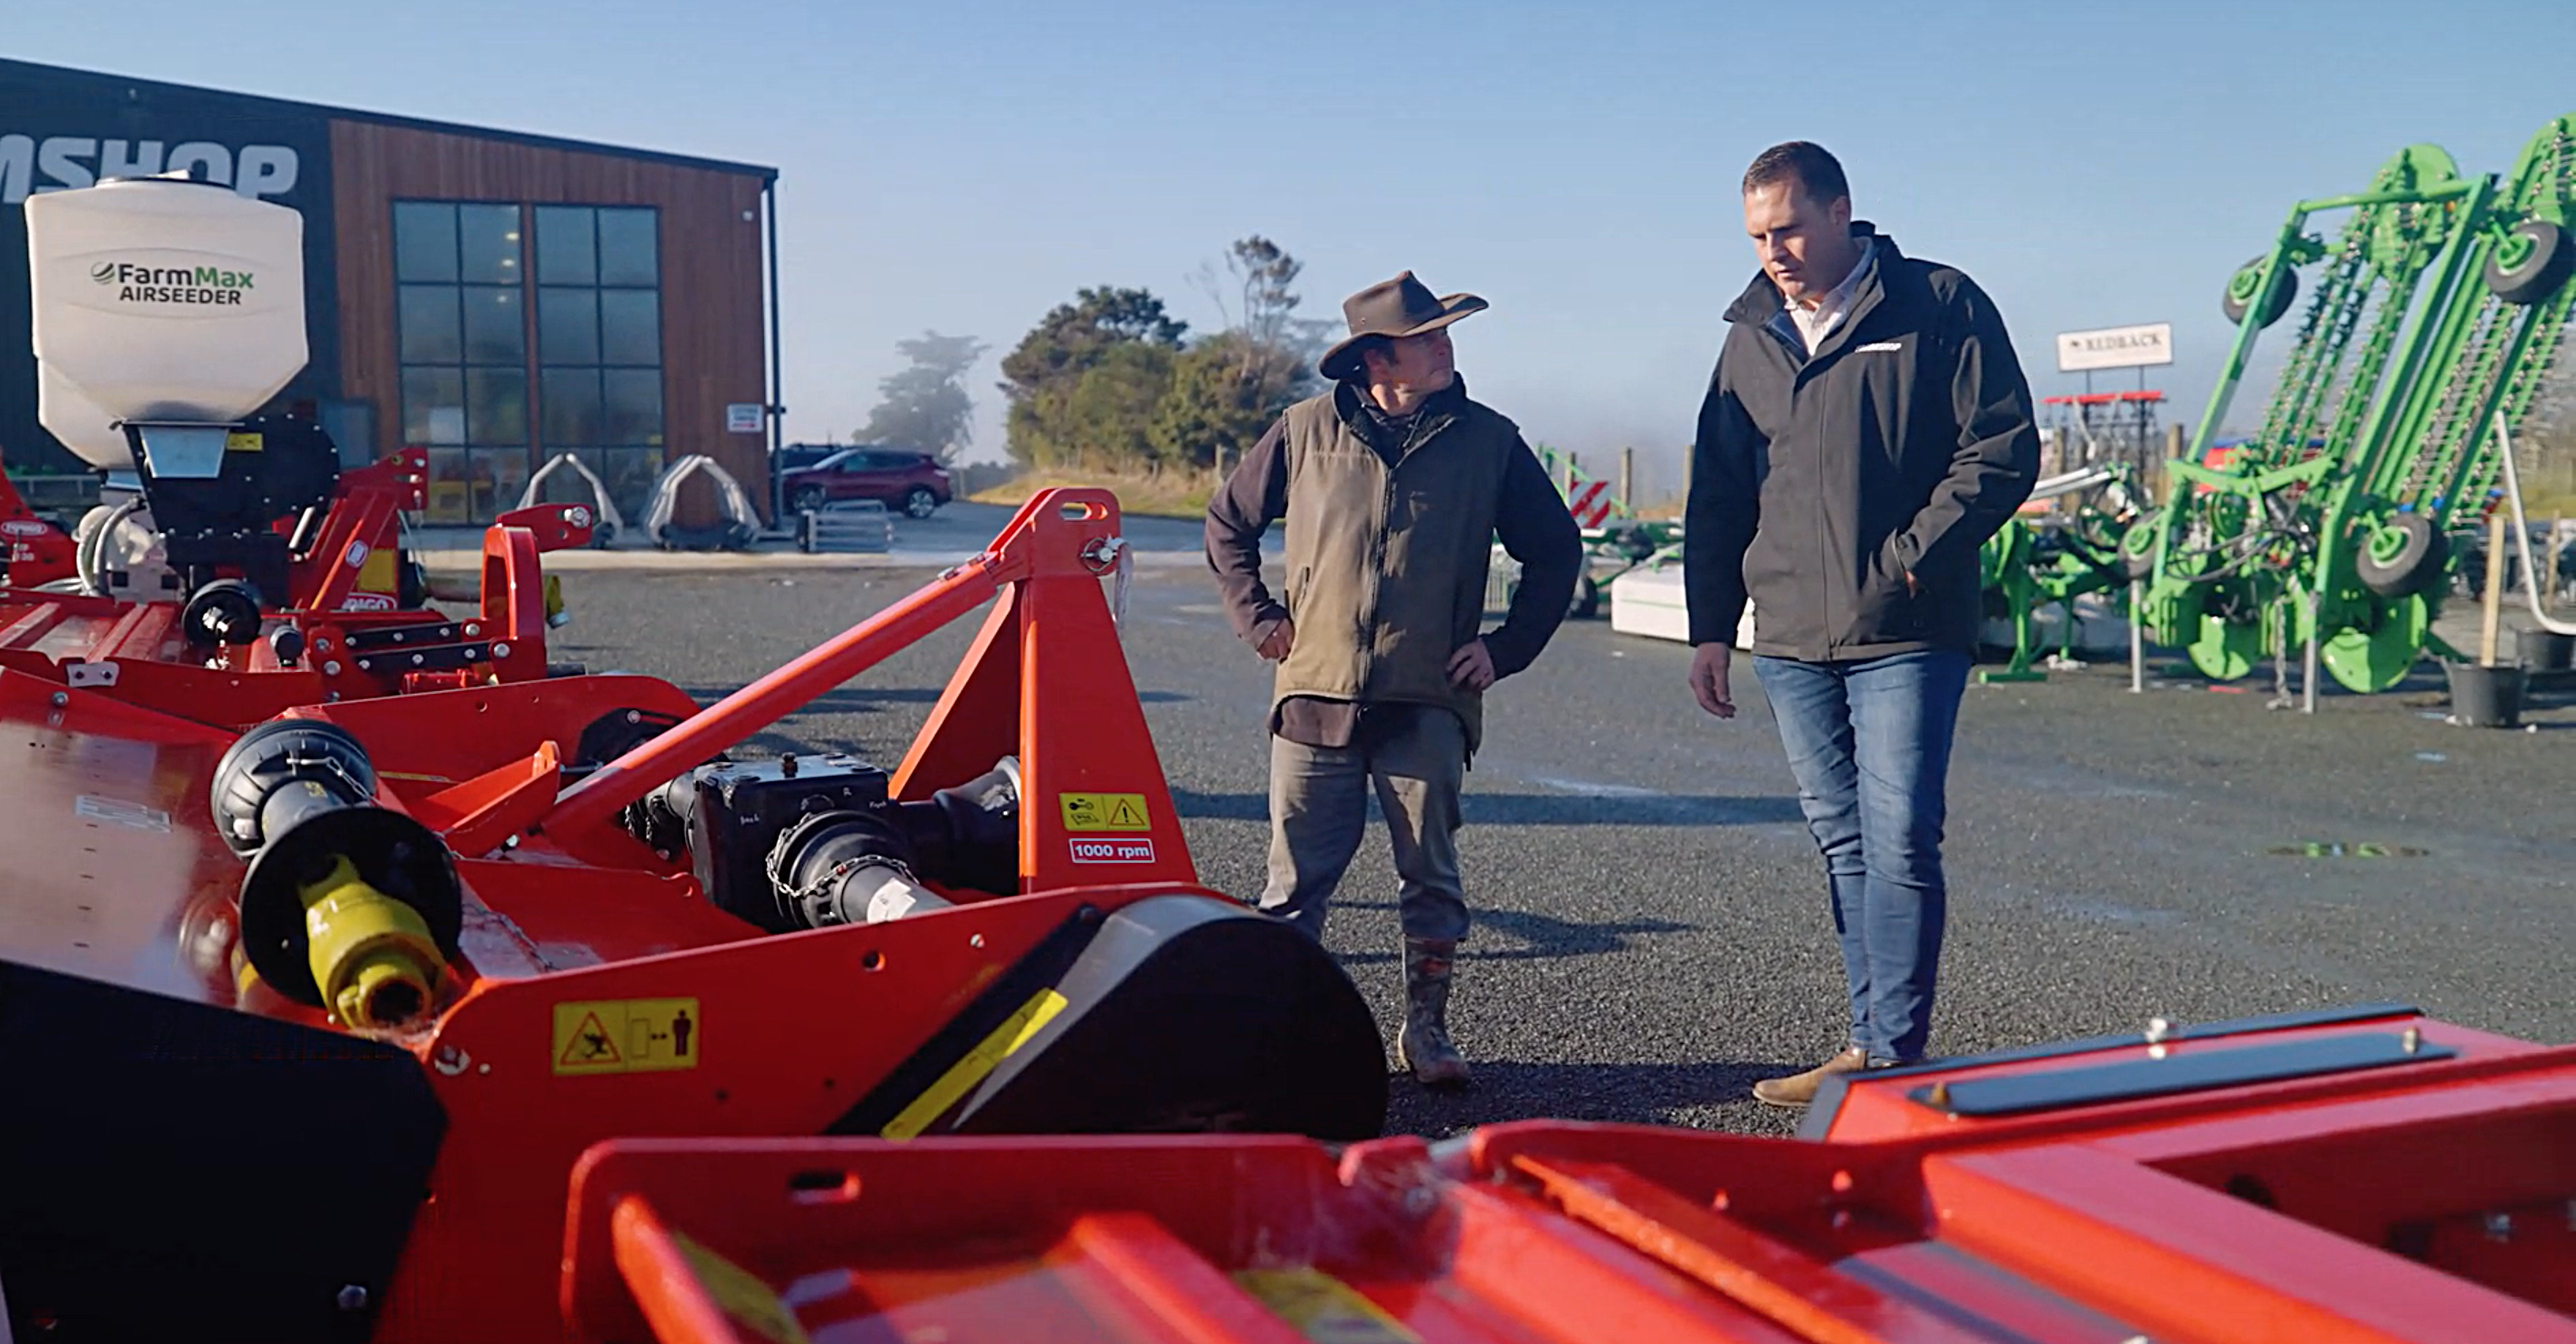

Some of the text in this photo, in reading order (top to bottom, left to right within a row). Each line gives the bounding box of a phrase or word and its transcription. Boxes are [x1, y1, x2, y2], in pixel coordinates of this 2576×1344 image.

[118, 264, 254, 288] FarmMax
[119, 286, 242, 305] AIRSEEDER
[1075, 845, 1150, 859] 1000 rpm
